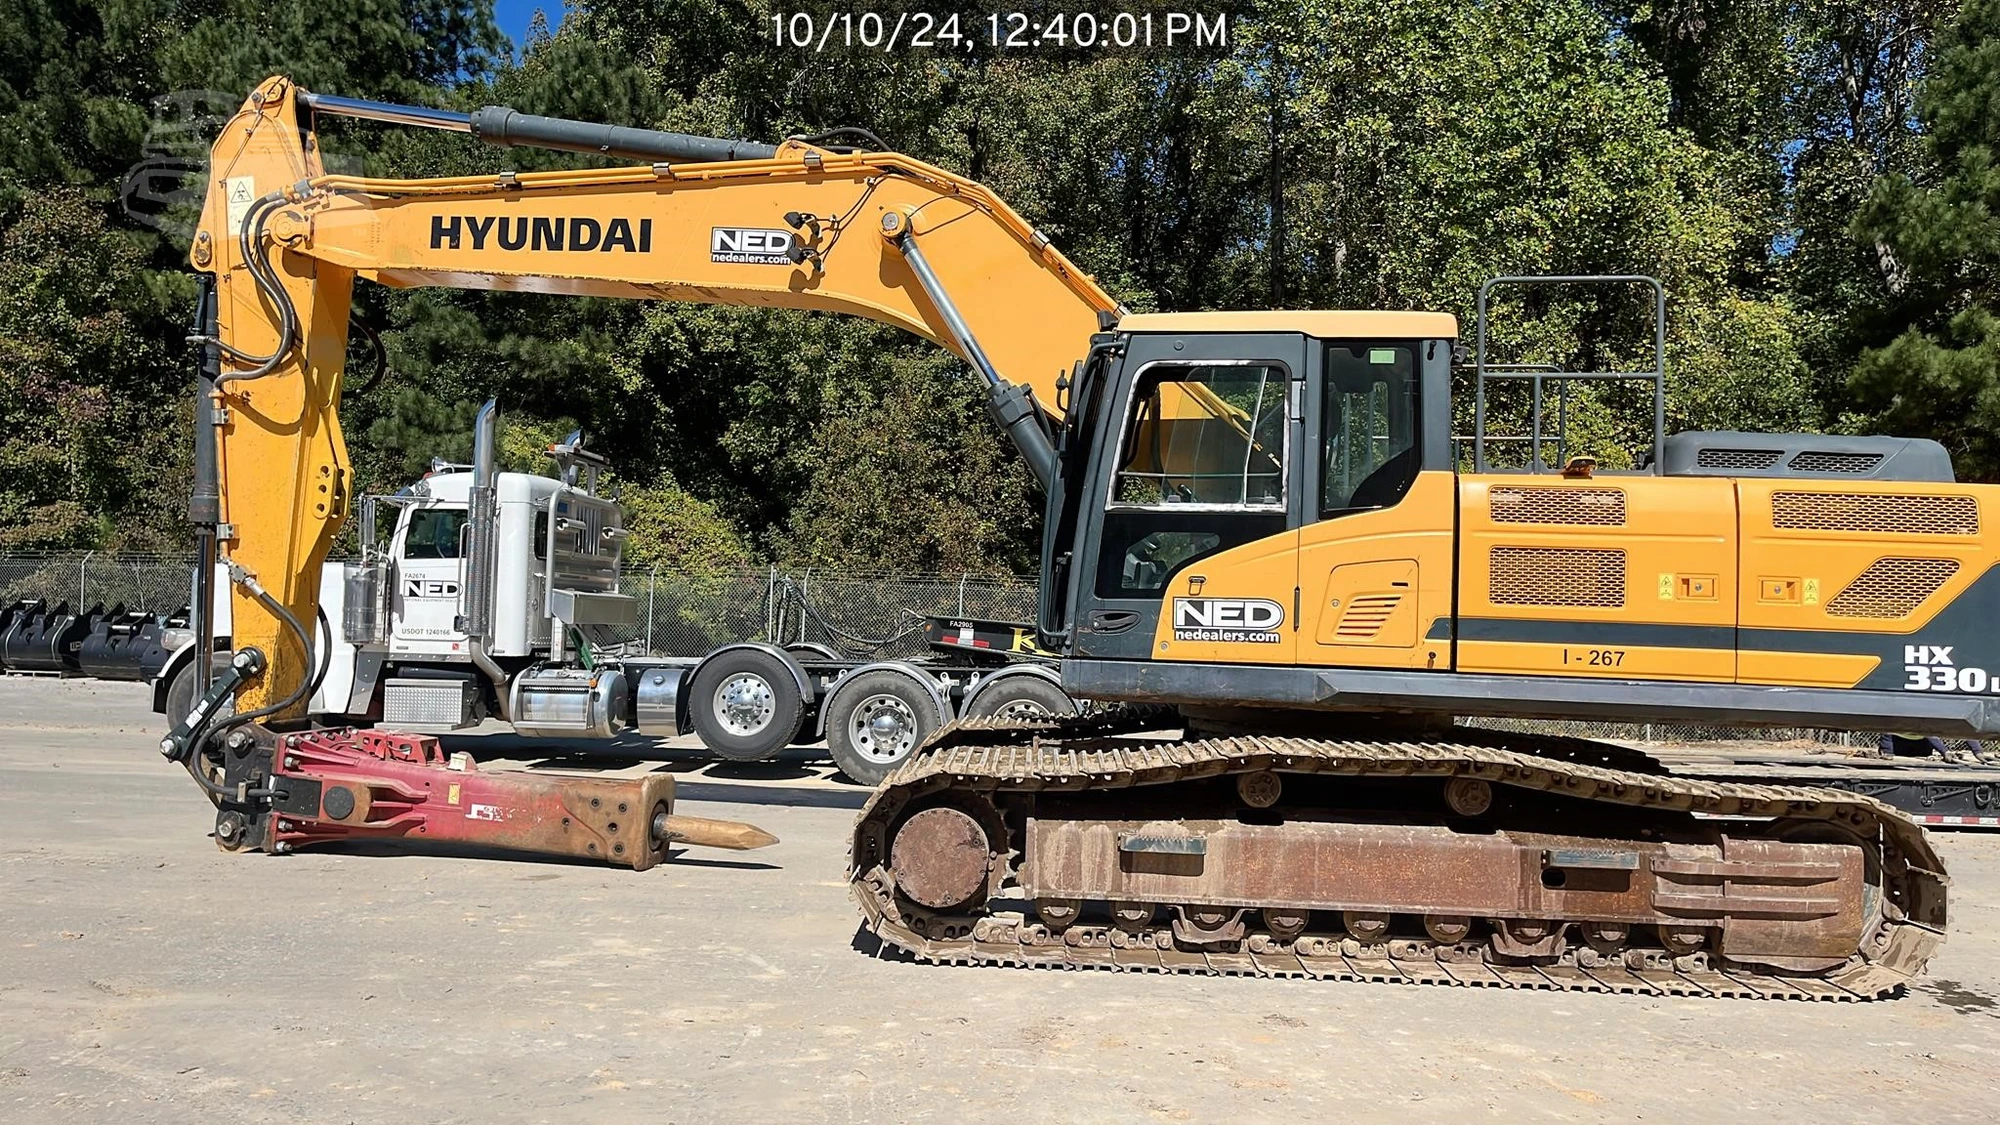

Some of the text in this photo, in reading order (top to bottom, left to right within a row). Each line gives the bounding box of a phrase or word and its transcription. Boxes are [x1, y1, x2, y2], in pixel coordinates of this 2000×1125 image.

[430, 216, 652, 253] HYUNDAI
[713, 229, 793, 252] NED
[712, 253, 791, 264] nedealers.com
[404, 580, 463, 598] NED
[1175, 599, 1282, 629] NED
[949, 620, 974, 629] FA2905
[1175, 629, 1279, 643] nedealers.com
[1588, 649, 1625, 667] 267
[1904, 644, 1954, 665] HX
